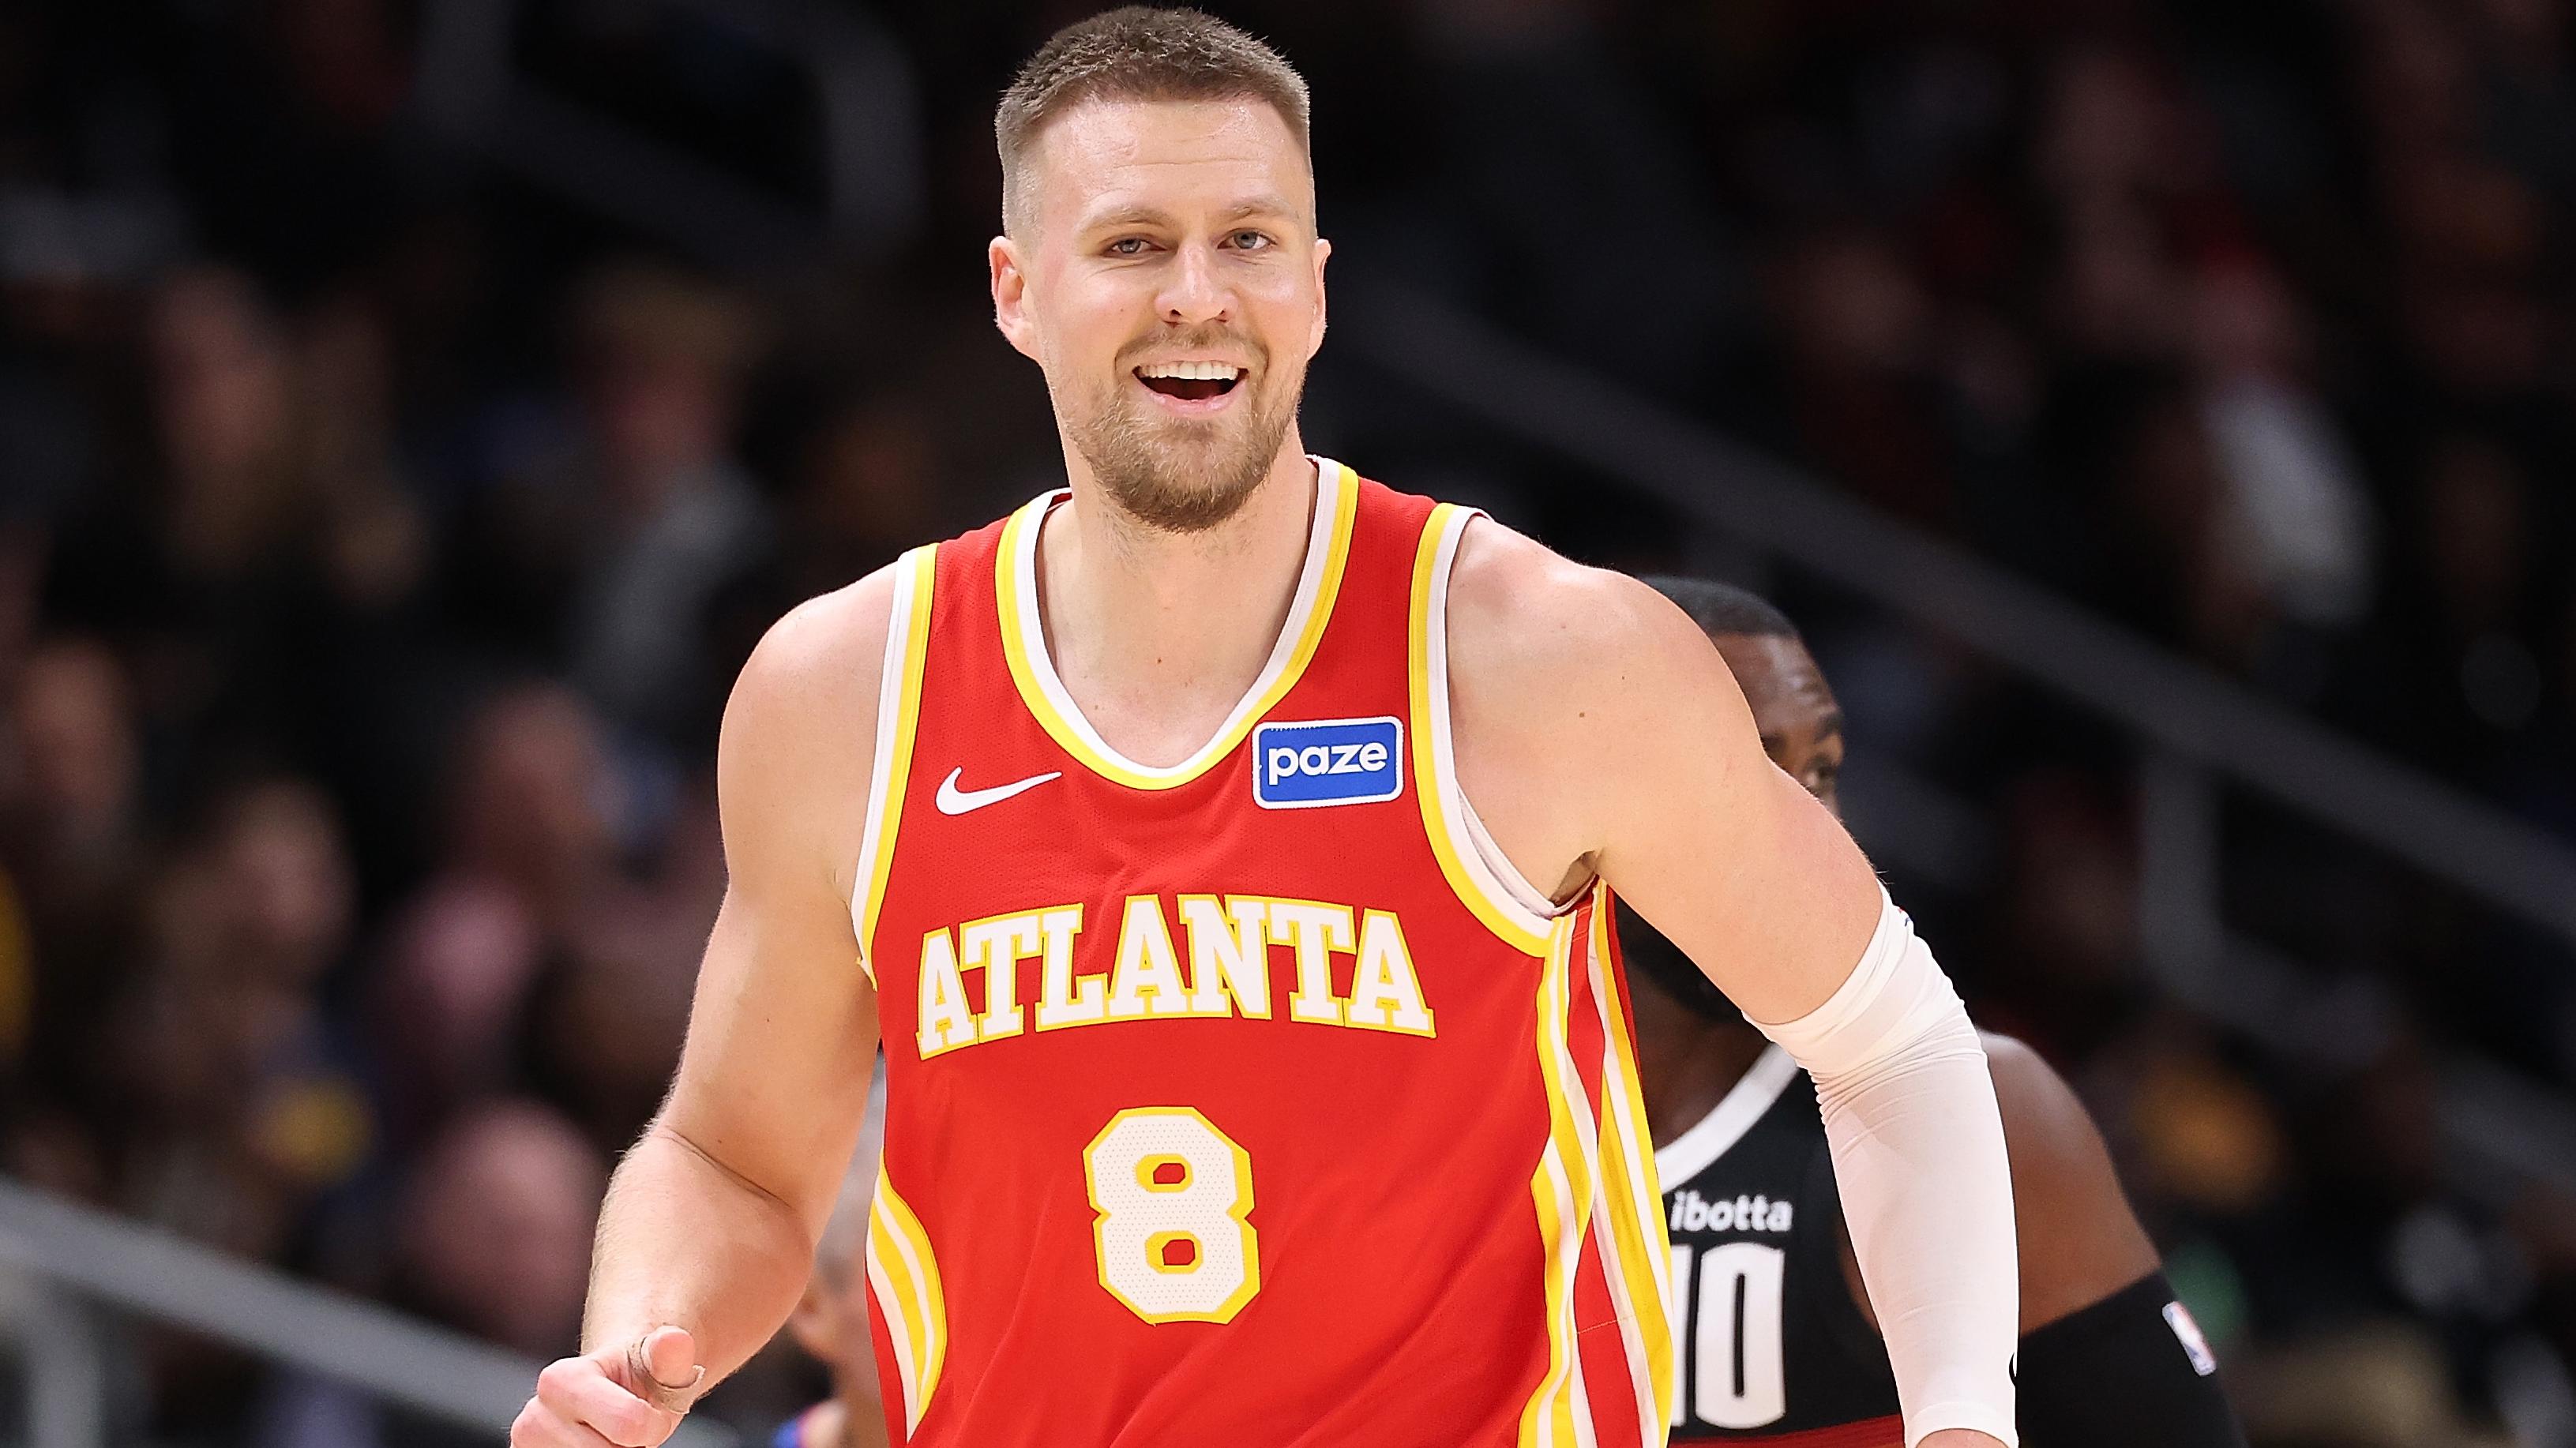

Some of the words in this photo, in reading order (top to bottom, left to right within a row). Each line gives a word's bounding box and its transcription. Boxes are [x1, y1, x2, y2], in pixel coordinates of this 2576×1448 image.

[1268, 742, 1388, 786] paze
[916, 894, 1436, 1060] ATLANTA
[1082, 1105, 1261, 1325] 8
[1670, 1190, 1793, 1232] ibotta
